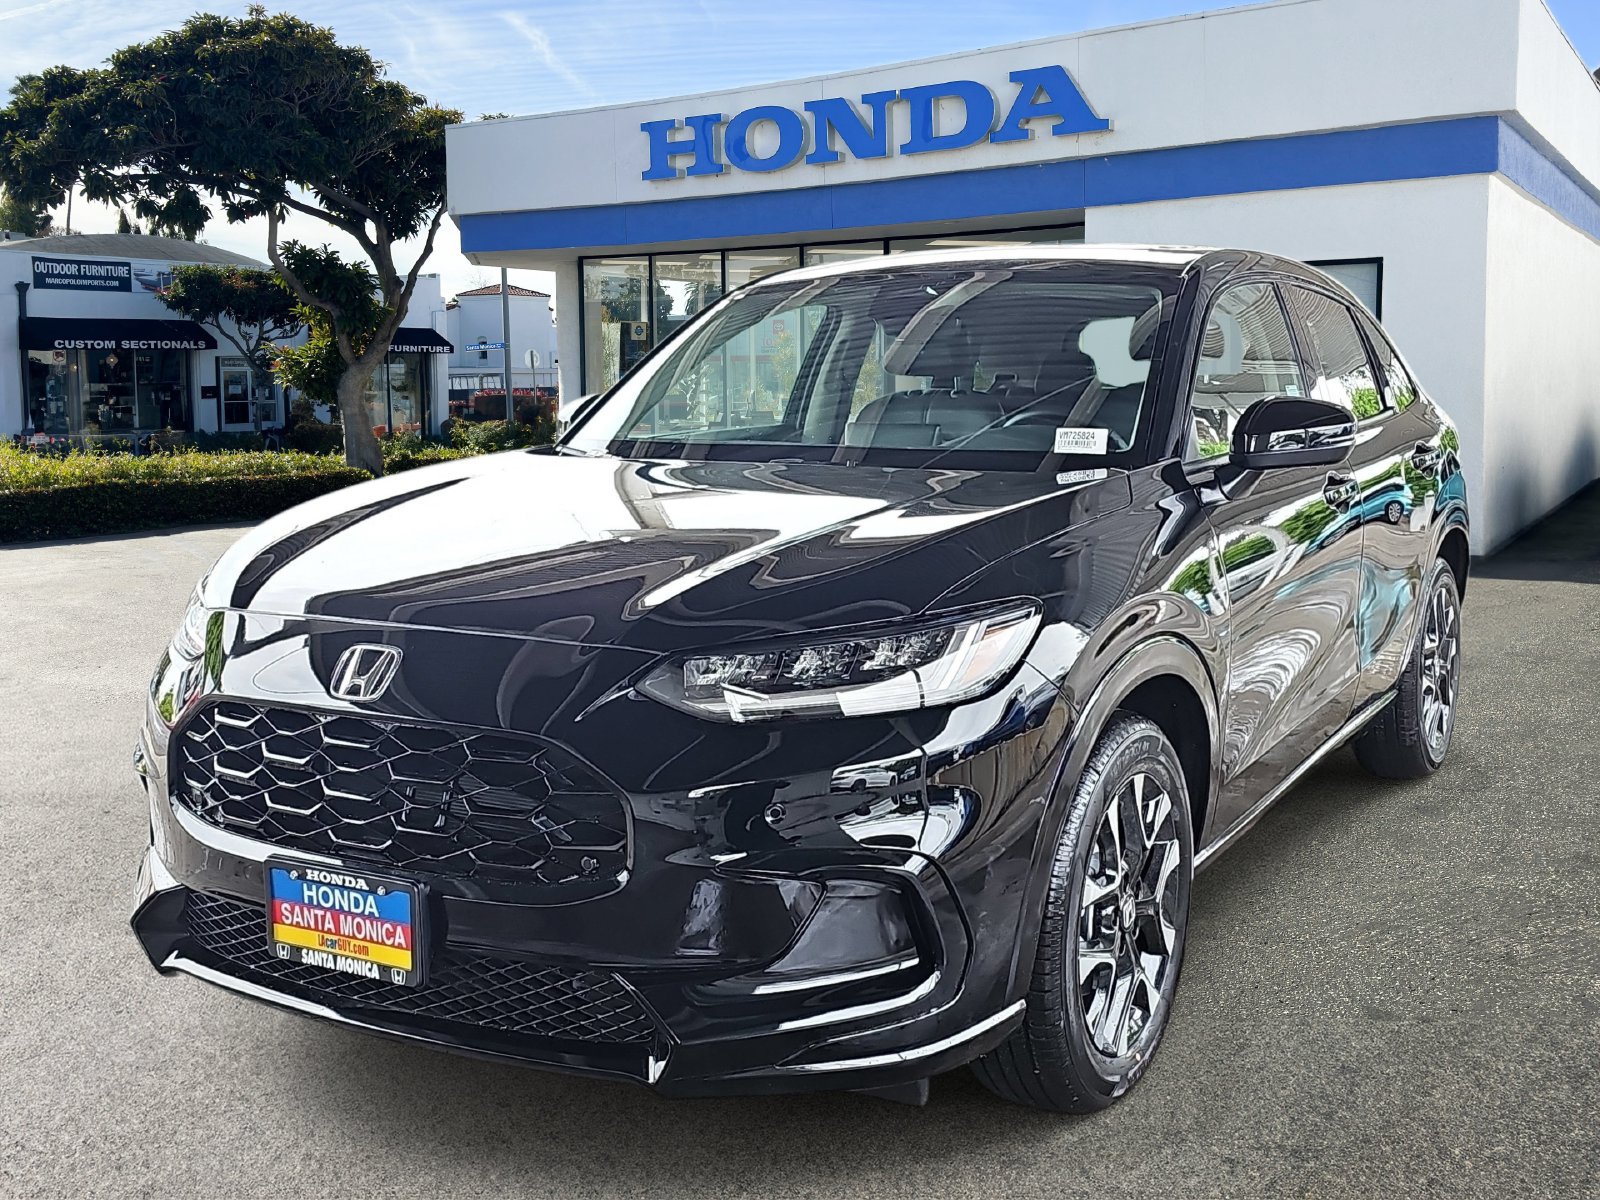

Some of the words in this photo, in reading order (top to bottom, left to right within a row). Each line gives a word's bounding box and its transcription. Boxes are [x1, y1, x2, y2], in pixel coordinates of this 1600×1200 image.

[641, 64, 1111, 181] HONDA
[34, 261, 79, 275] OUTDOOR
[80, 265, 130, 277] FURNITURE
[45, 277, 119, 287] MARCOPOLOIMPORTS.COM
[54, 339, 116, 349] CUSTOM
[121, 339, 206, 349] SECTIONALS
[388, 344, 451, 353] FURNITURE
[306, 868, 370, 891] HONDA
[302, 882, 380, 918] HONDA
[280, 903, 336, 933] SANTA
[339, 914, 407, 948] MONICA
[317, 934, 370, 957] LAcarGUY.com
[301, 948, 337, 970] SANTA
[336, 956, 381, 980] MONICA
